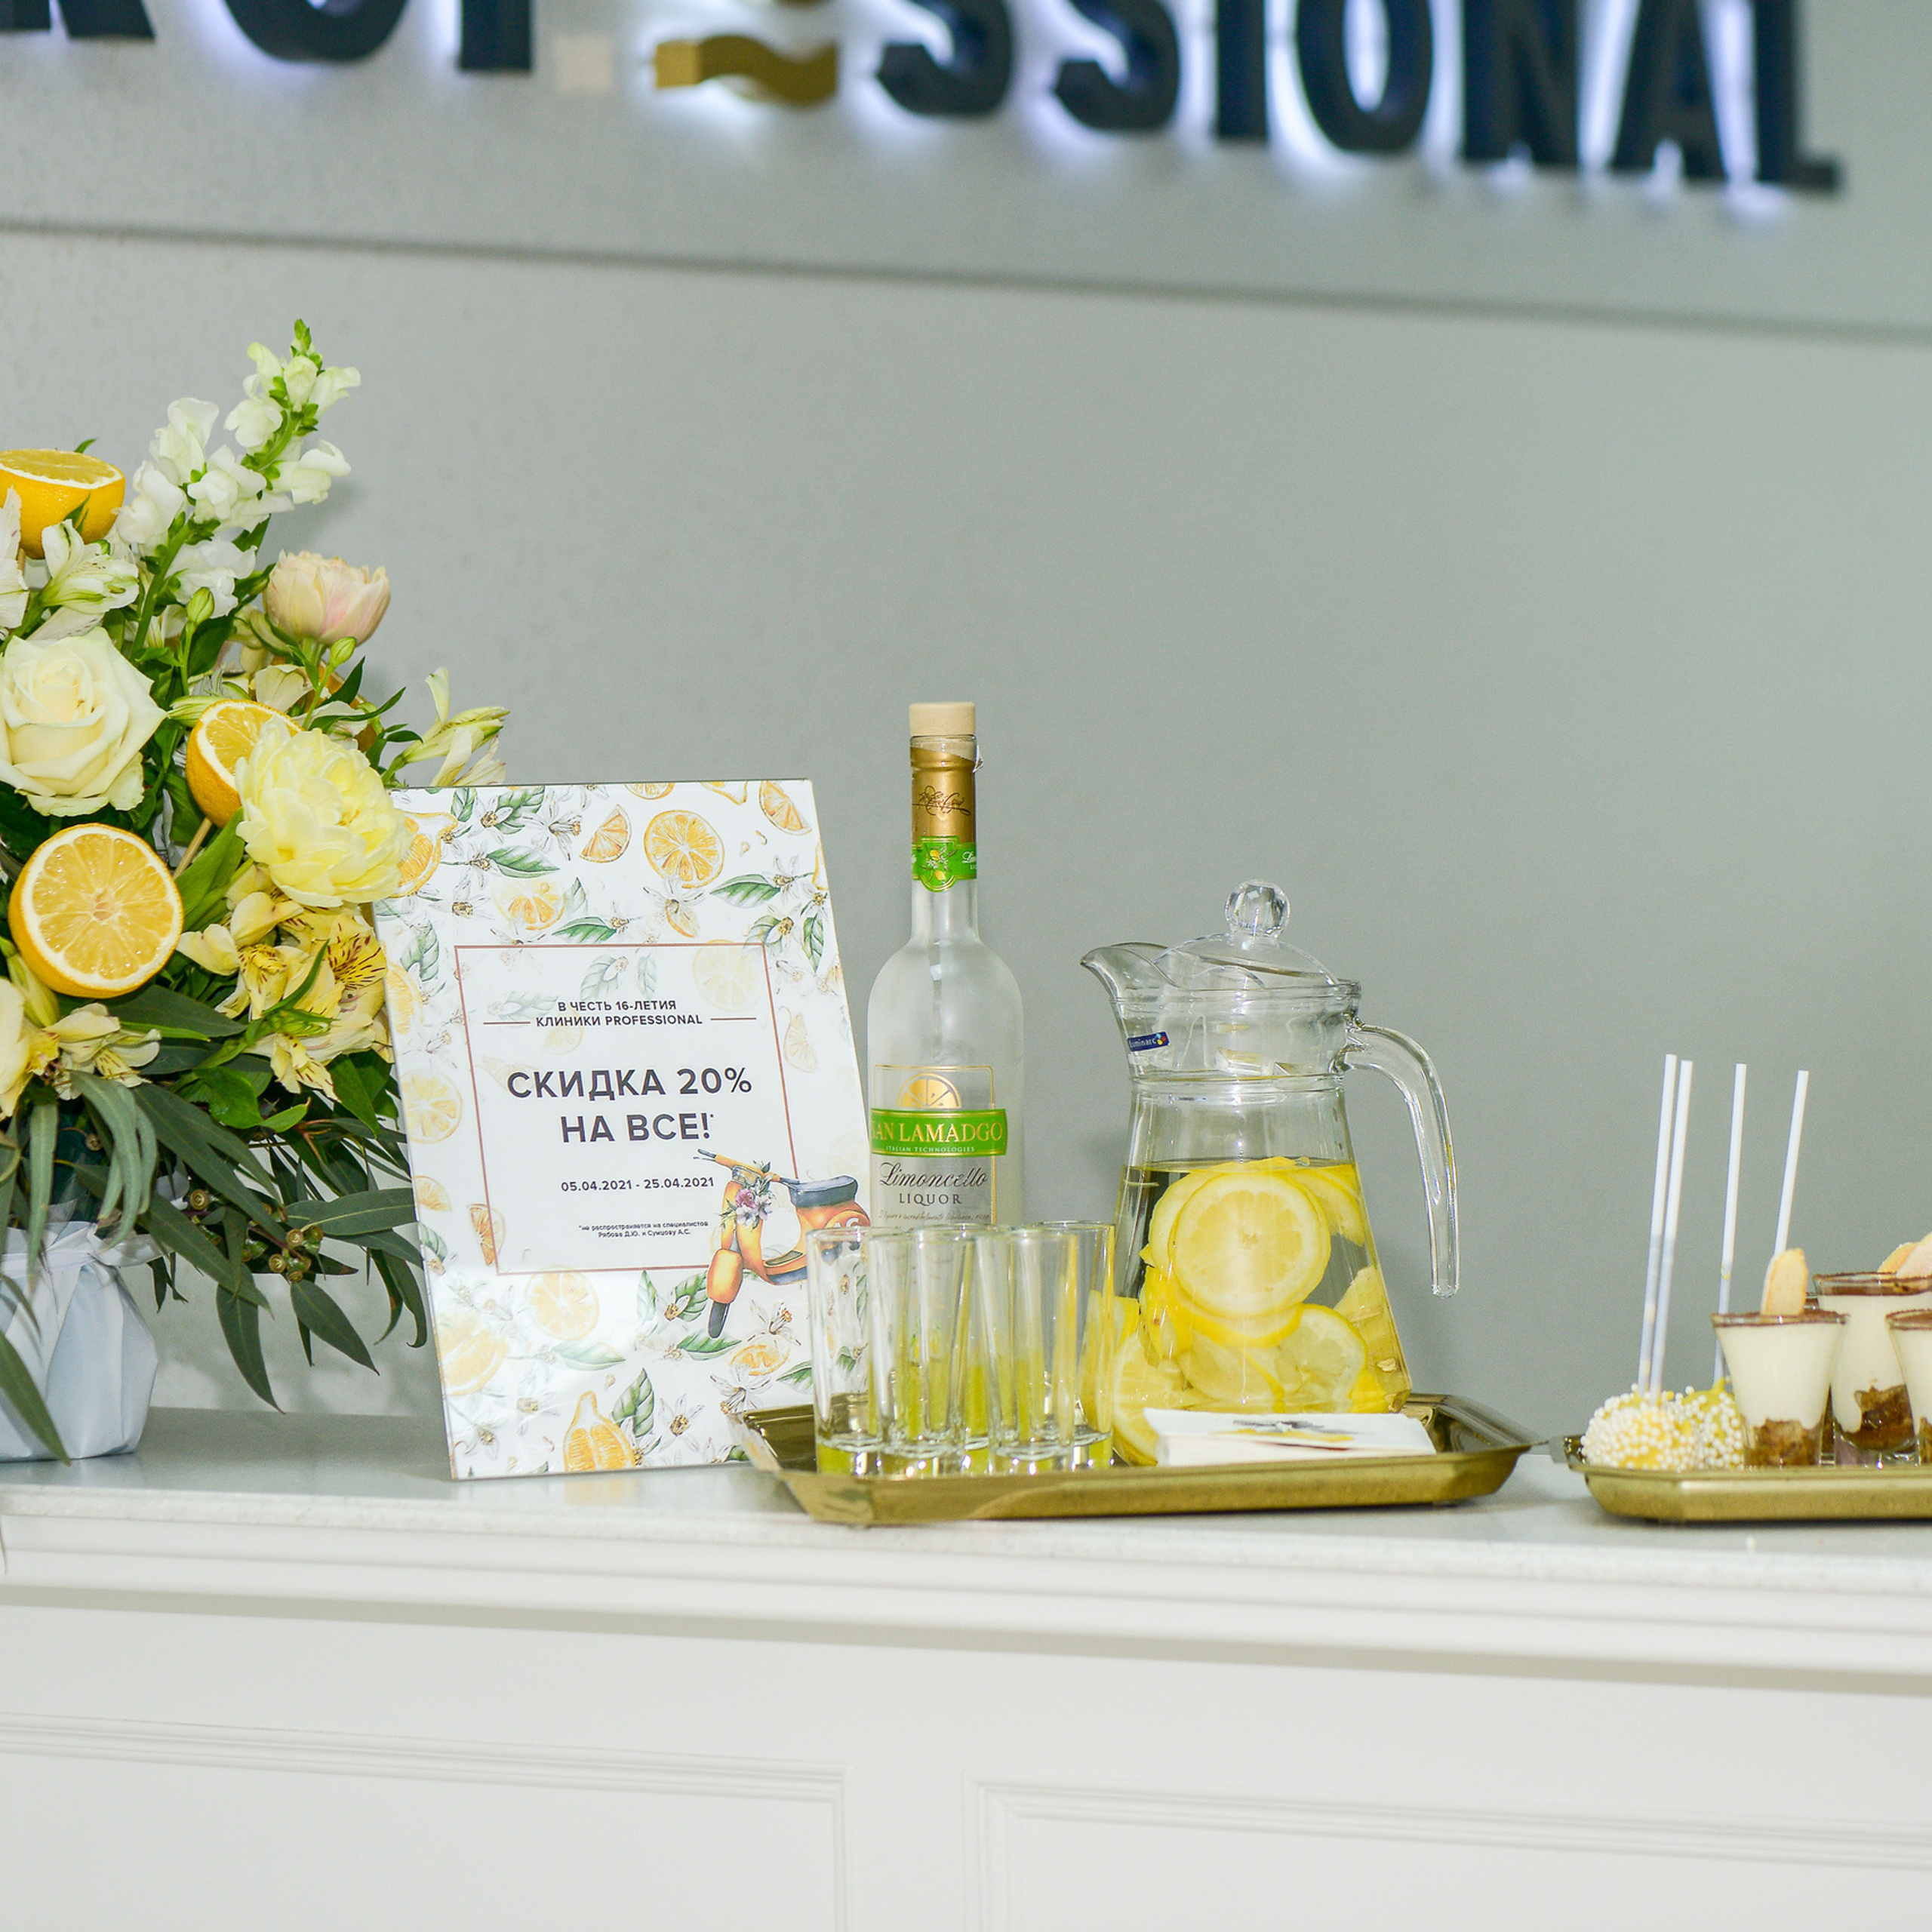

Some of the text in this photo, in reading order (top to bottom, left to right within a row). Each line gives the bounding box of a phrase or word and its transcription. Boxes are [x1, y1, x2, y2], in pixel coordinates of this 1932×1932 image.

[558, 1000, 677, 1012] В ЧЕСТЬ 16-ЛЕТИЯ
[536, 1014, 703, 1027] КЛИНИКИ PROFESSIONAL
[507, 1066, 752, 1102] СКИДКА 20%
[561, 1115, 615, 1143] НА
[898, 1121, 1003, 1143] LAMADGO
[879, 1162, 989, 1188] Limoncello
[561, 1180, 632, 1192] 05.04.2021
[643, 1177, 715, 1190] 25.04.2021
[899, 1193, 962, 1206] LIQUOR
